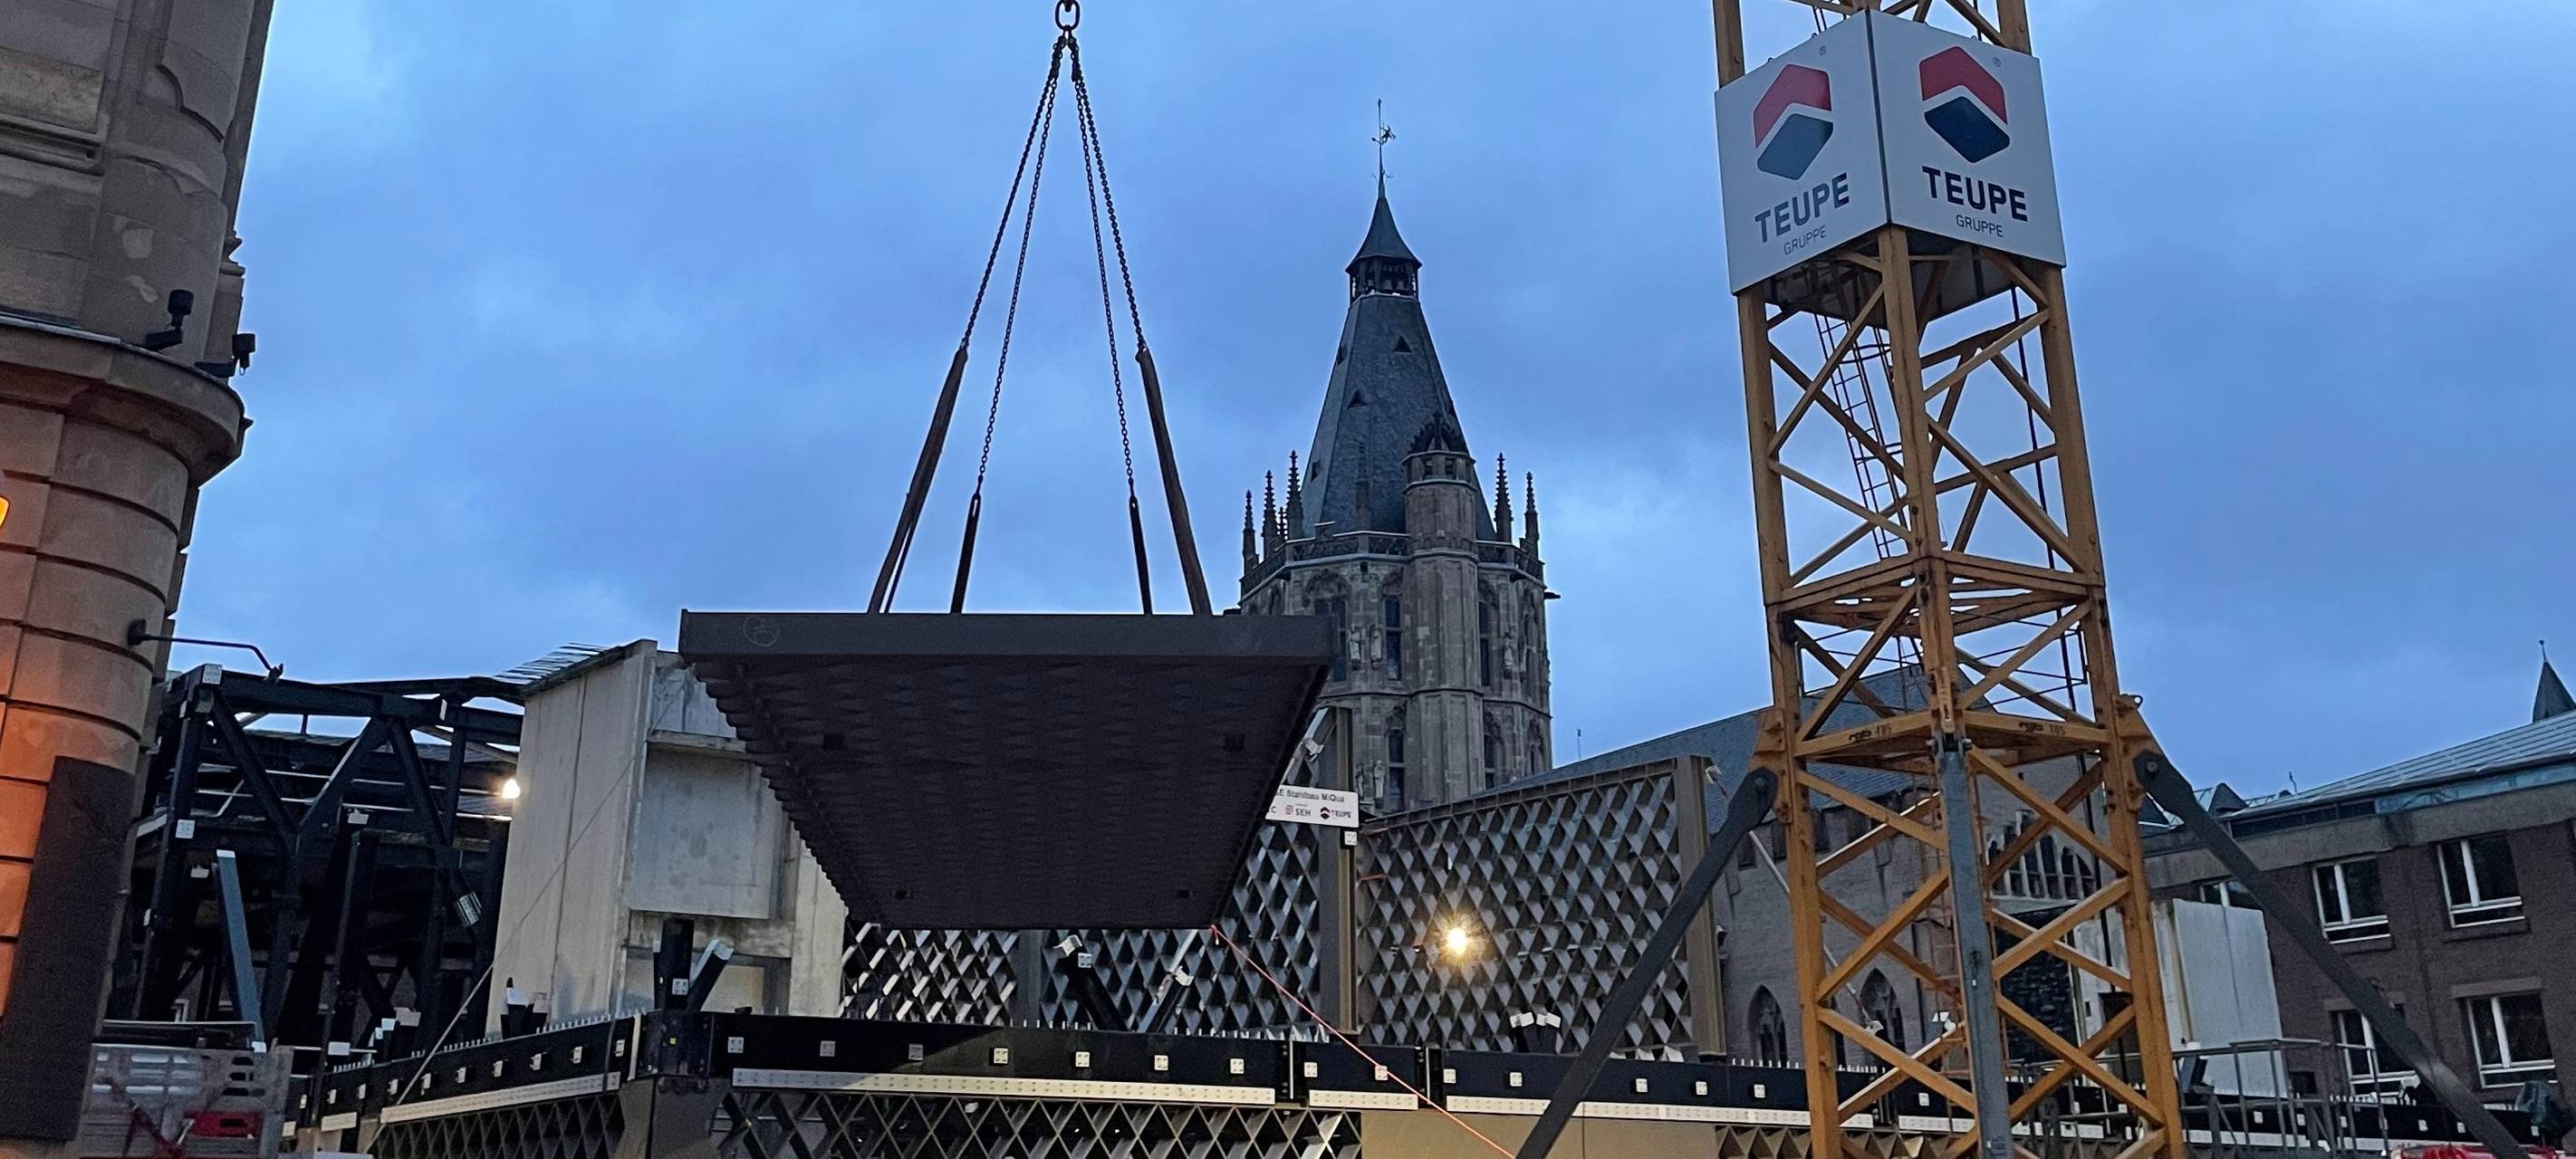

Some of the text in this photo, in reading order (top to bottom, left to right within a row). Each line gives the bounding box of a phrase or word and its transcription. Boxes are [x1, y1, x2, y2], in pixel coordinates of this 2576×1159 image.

[1754, 172, 1850, 244] TEUPE
[1921, 165, 2029, 223] TEUPE
[1783, 225, 1828, 255] GRUPPE
[1955, 214, 2004, 238] GRUPPE
